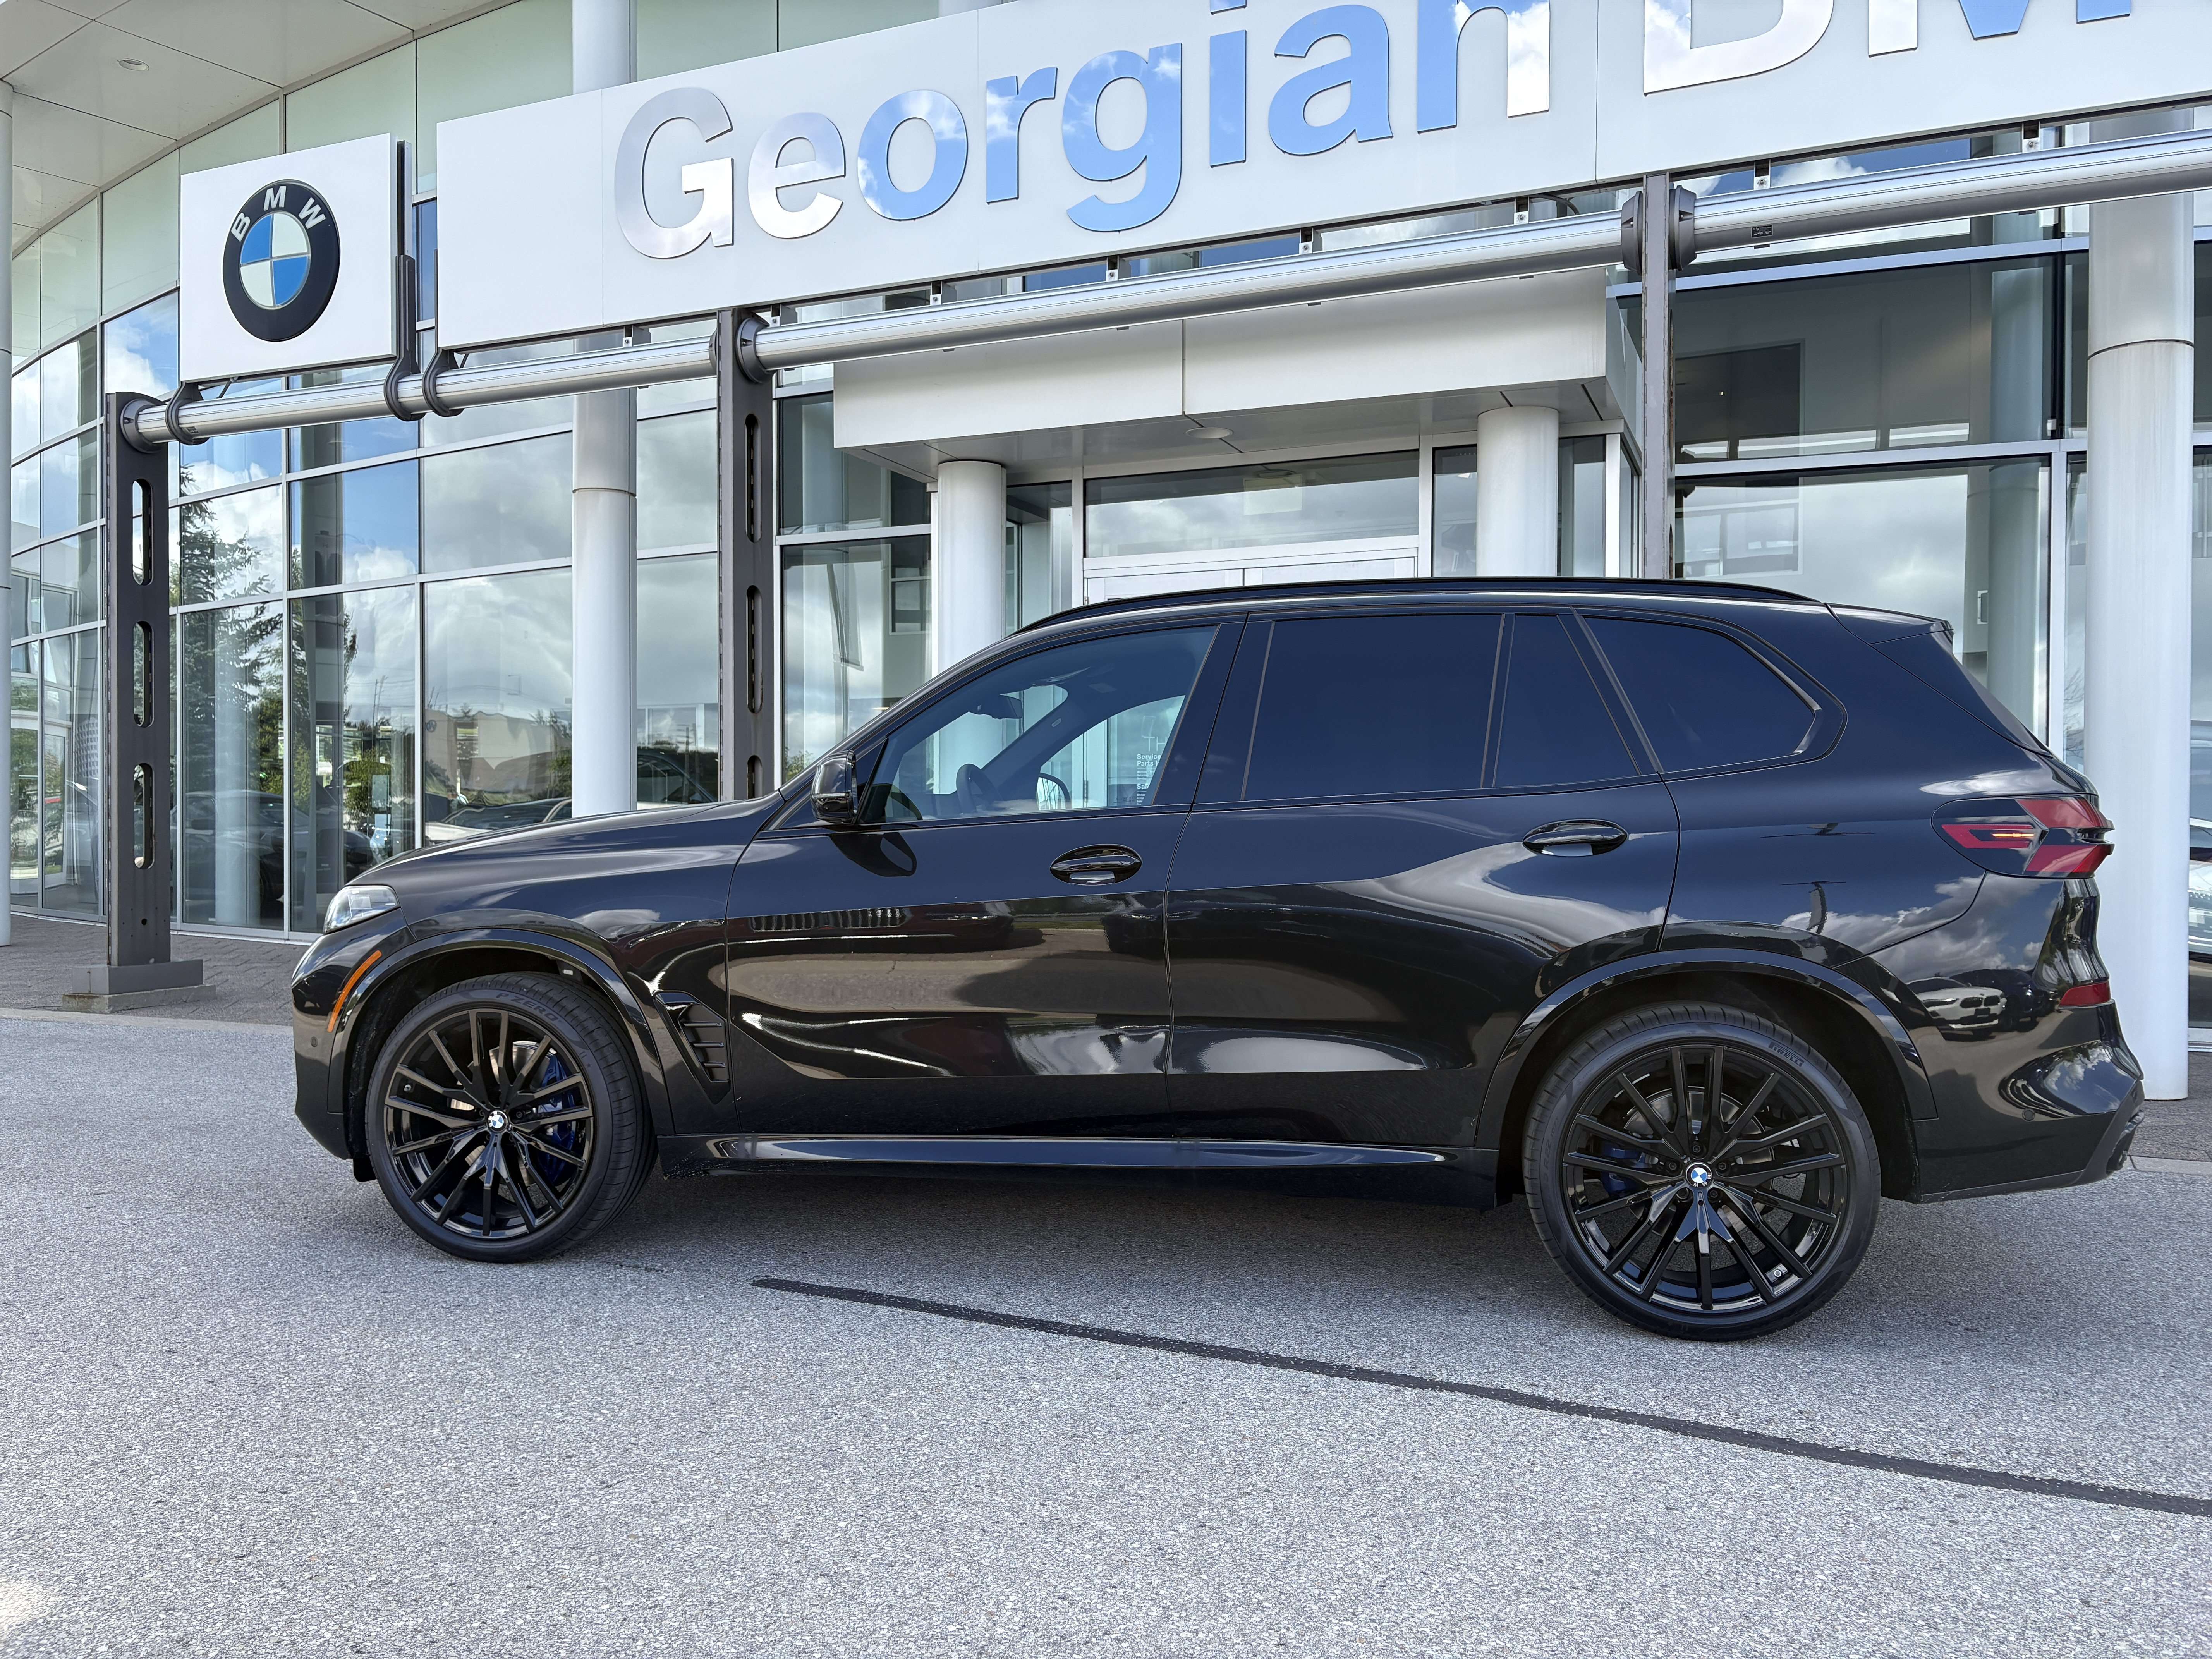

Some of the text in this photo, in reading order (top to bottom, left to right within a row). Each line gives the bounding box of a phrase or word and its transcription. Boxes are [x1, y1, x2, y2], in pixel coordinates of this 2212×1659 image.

[613, 0, 1550, 259] Georgian
[231, 185, 326, 229] BMW
[511, 996, 559, 1022] ZERO
[1768, 1041, 1805, 1067] PIRELLI
